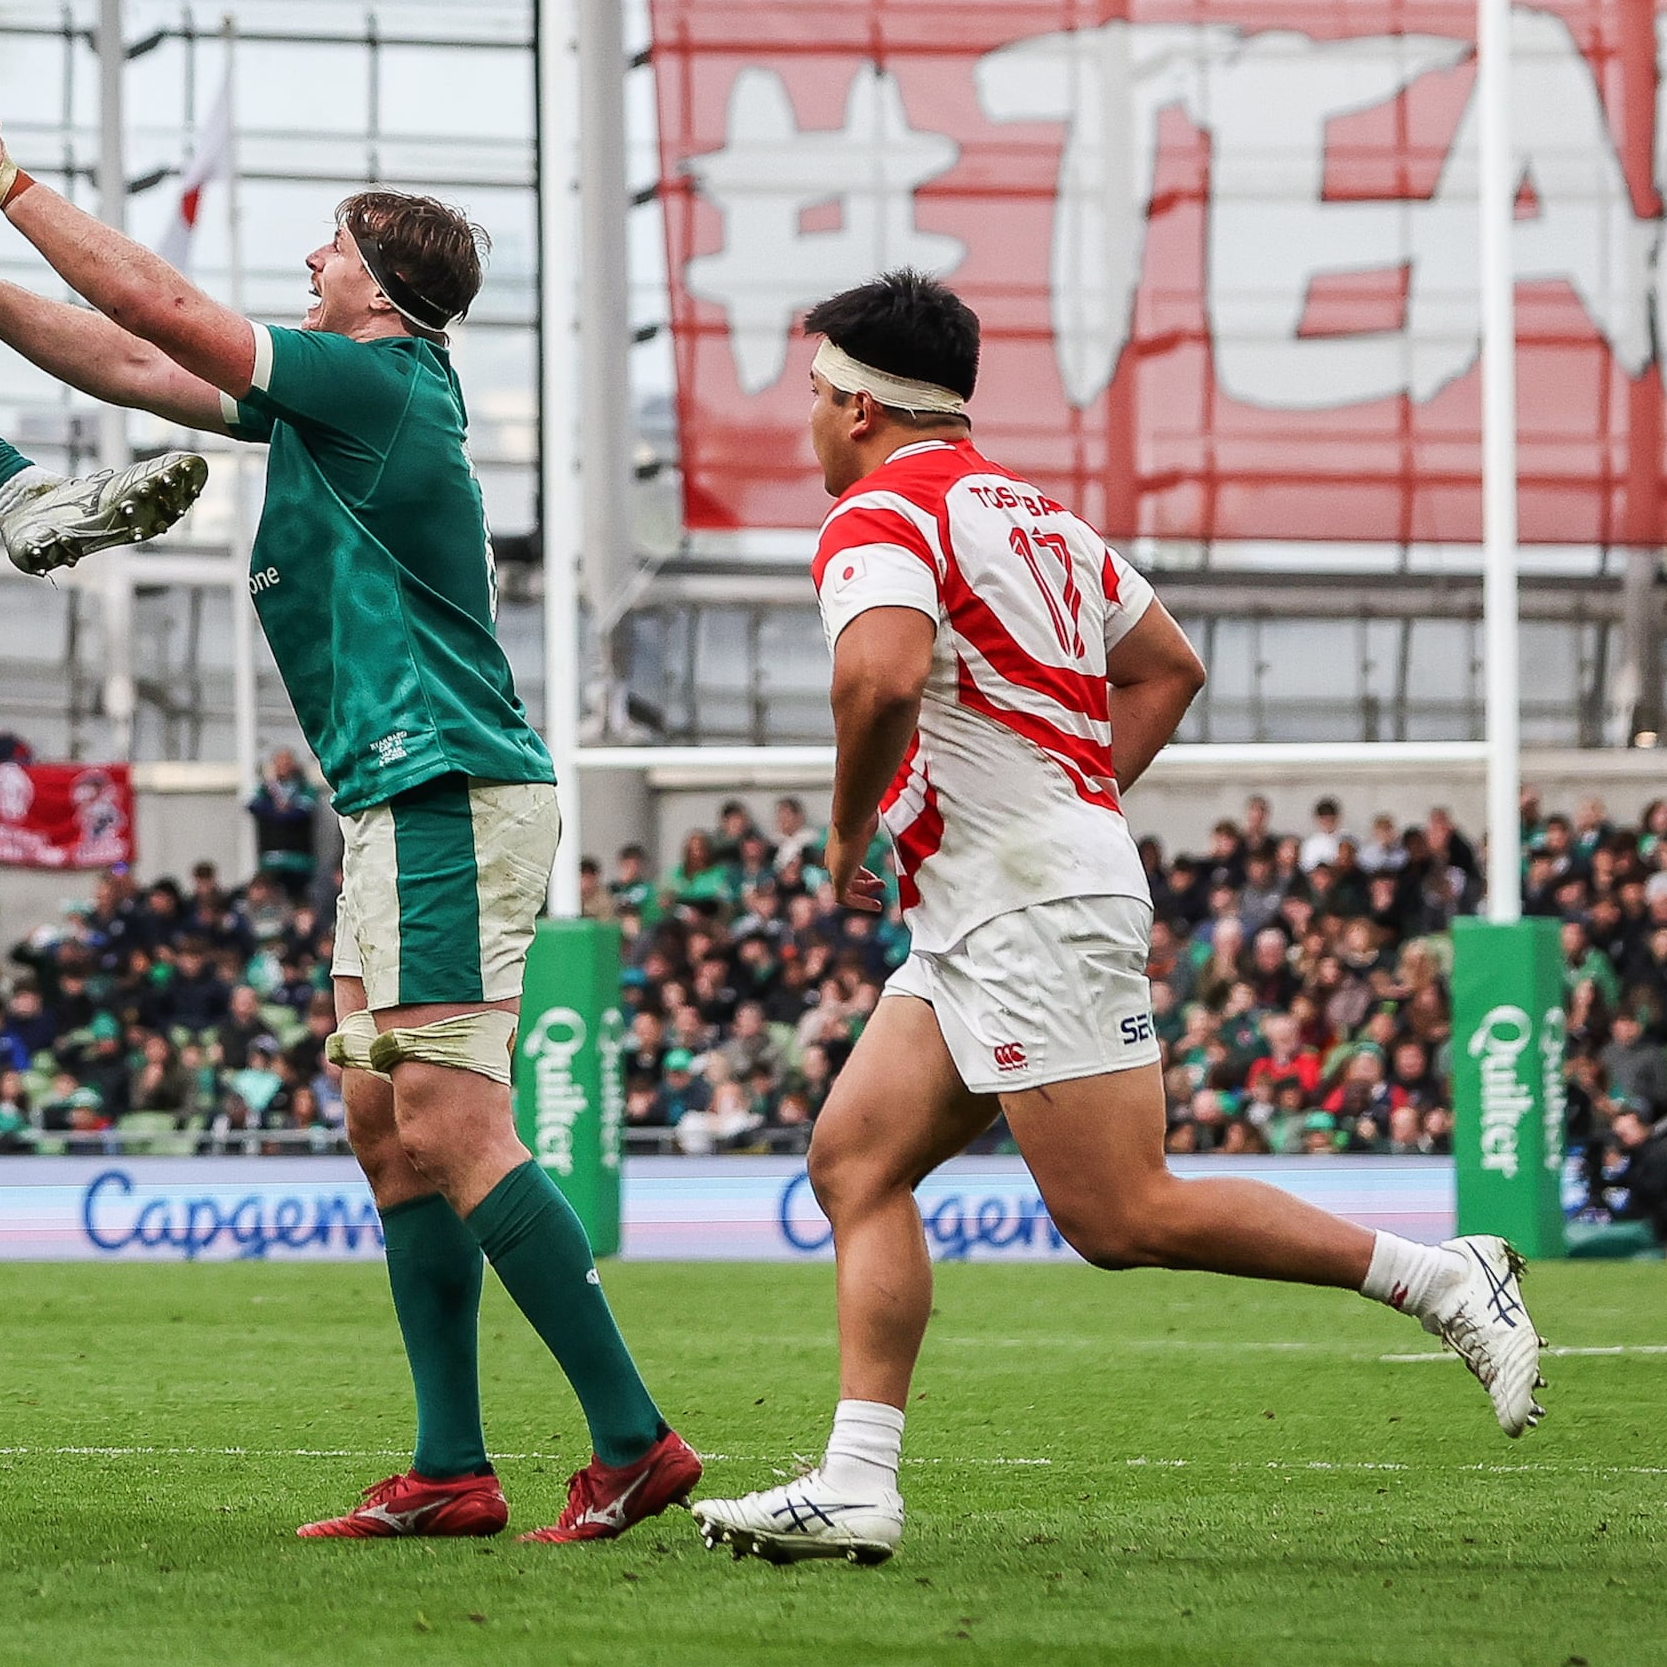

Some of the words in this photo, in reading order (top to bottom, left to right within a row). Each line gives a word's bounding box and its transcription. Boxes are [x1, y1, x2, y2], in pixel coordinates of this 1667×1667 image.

[678, 6, 1667, 412] #TEA
[1009, 526, 1086, 660] 17
[523, 1006, 589, 1177] Quilter
[1467, 1004, 1535, 1180] Quilter
[81, 1168, 385, 1261] Capgem
